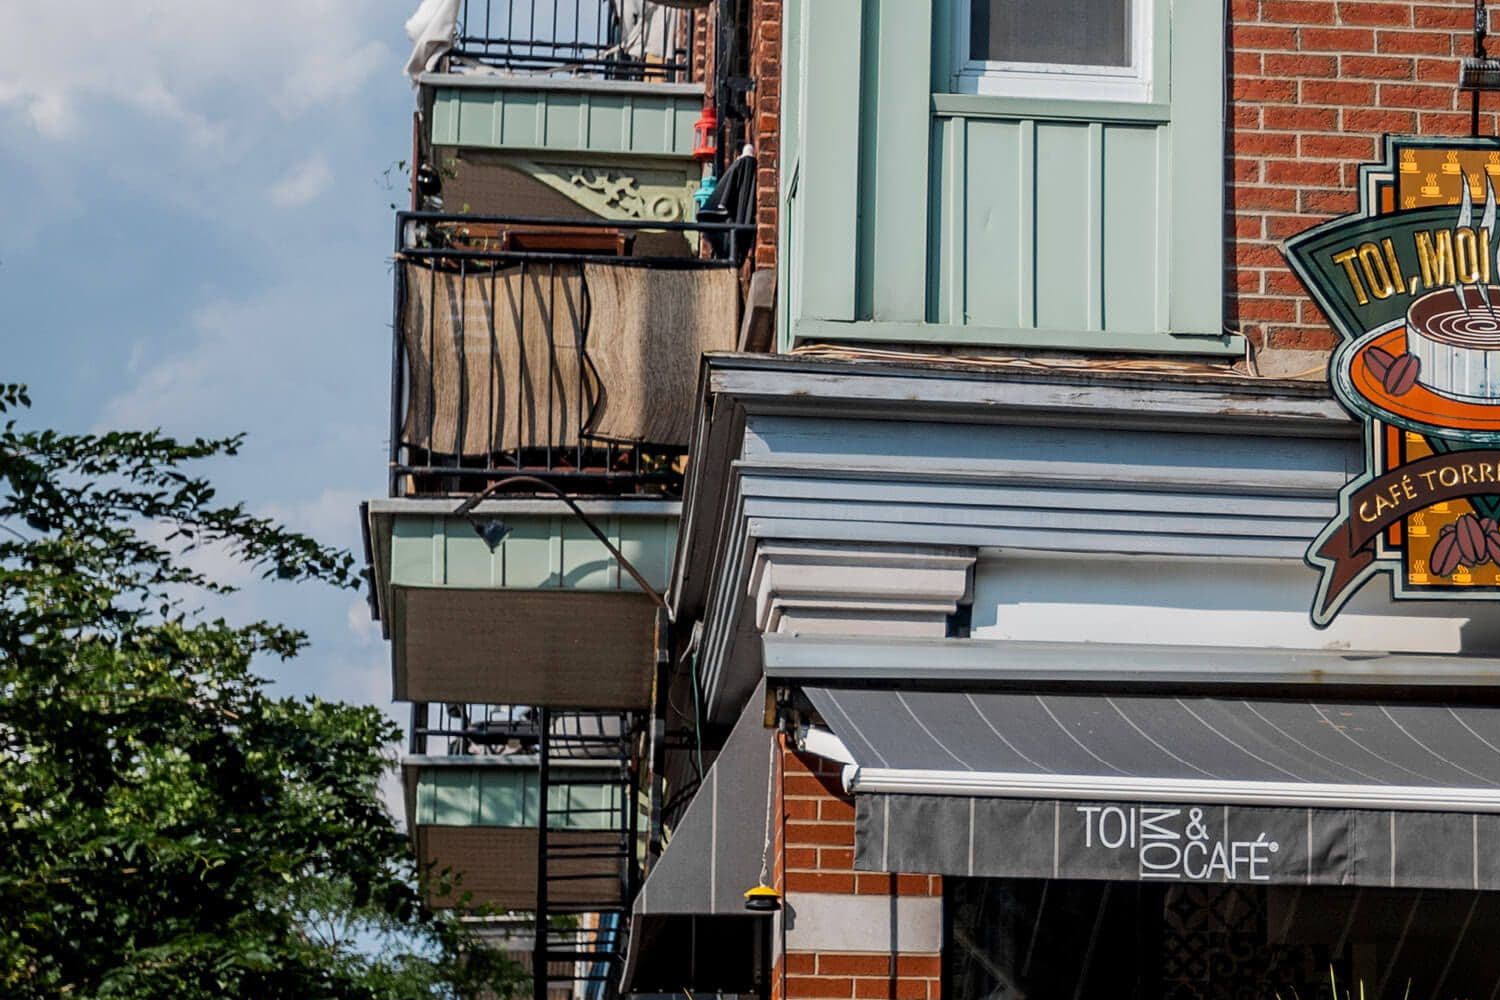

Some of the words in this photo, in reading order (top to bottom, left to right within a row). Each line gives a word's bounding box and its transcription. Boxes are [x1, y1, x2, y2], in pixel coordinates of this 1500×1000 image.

[1332, 237, 1418, 305] TOI,
[1414, 227, 1493, 288] MOI
[1359, 474, 1418, 524] CAFÉ
[1076, 806, 1136, 849] TOI
[1139, 807, 1181, 879] MOI
[1185, 806, 1210, 841] &
